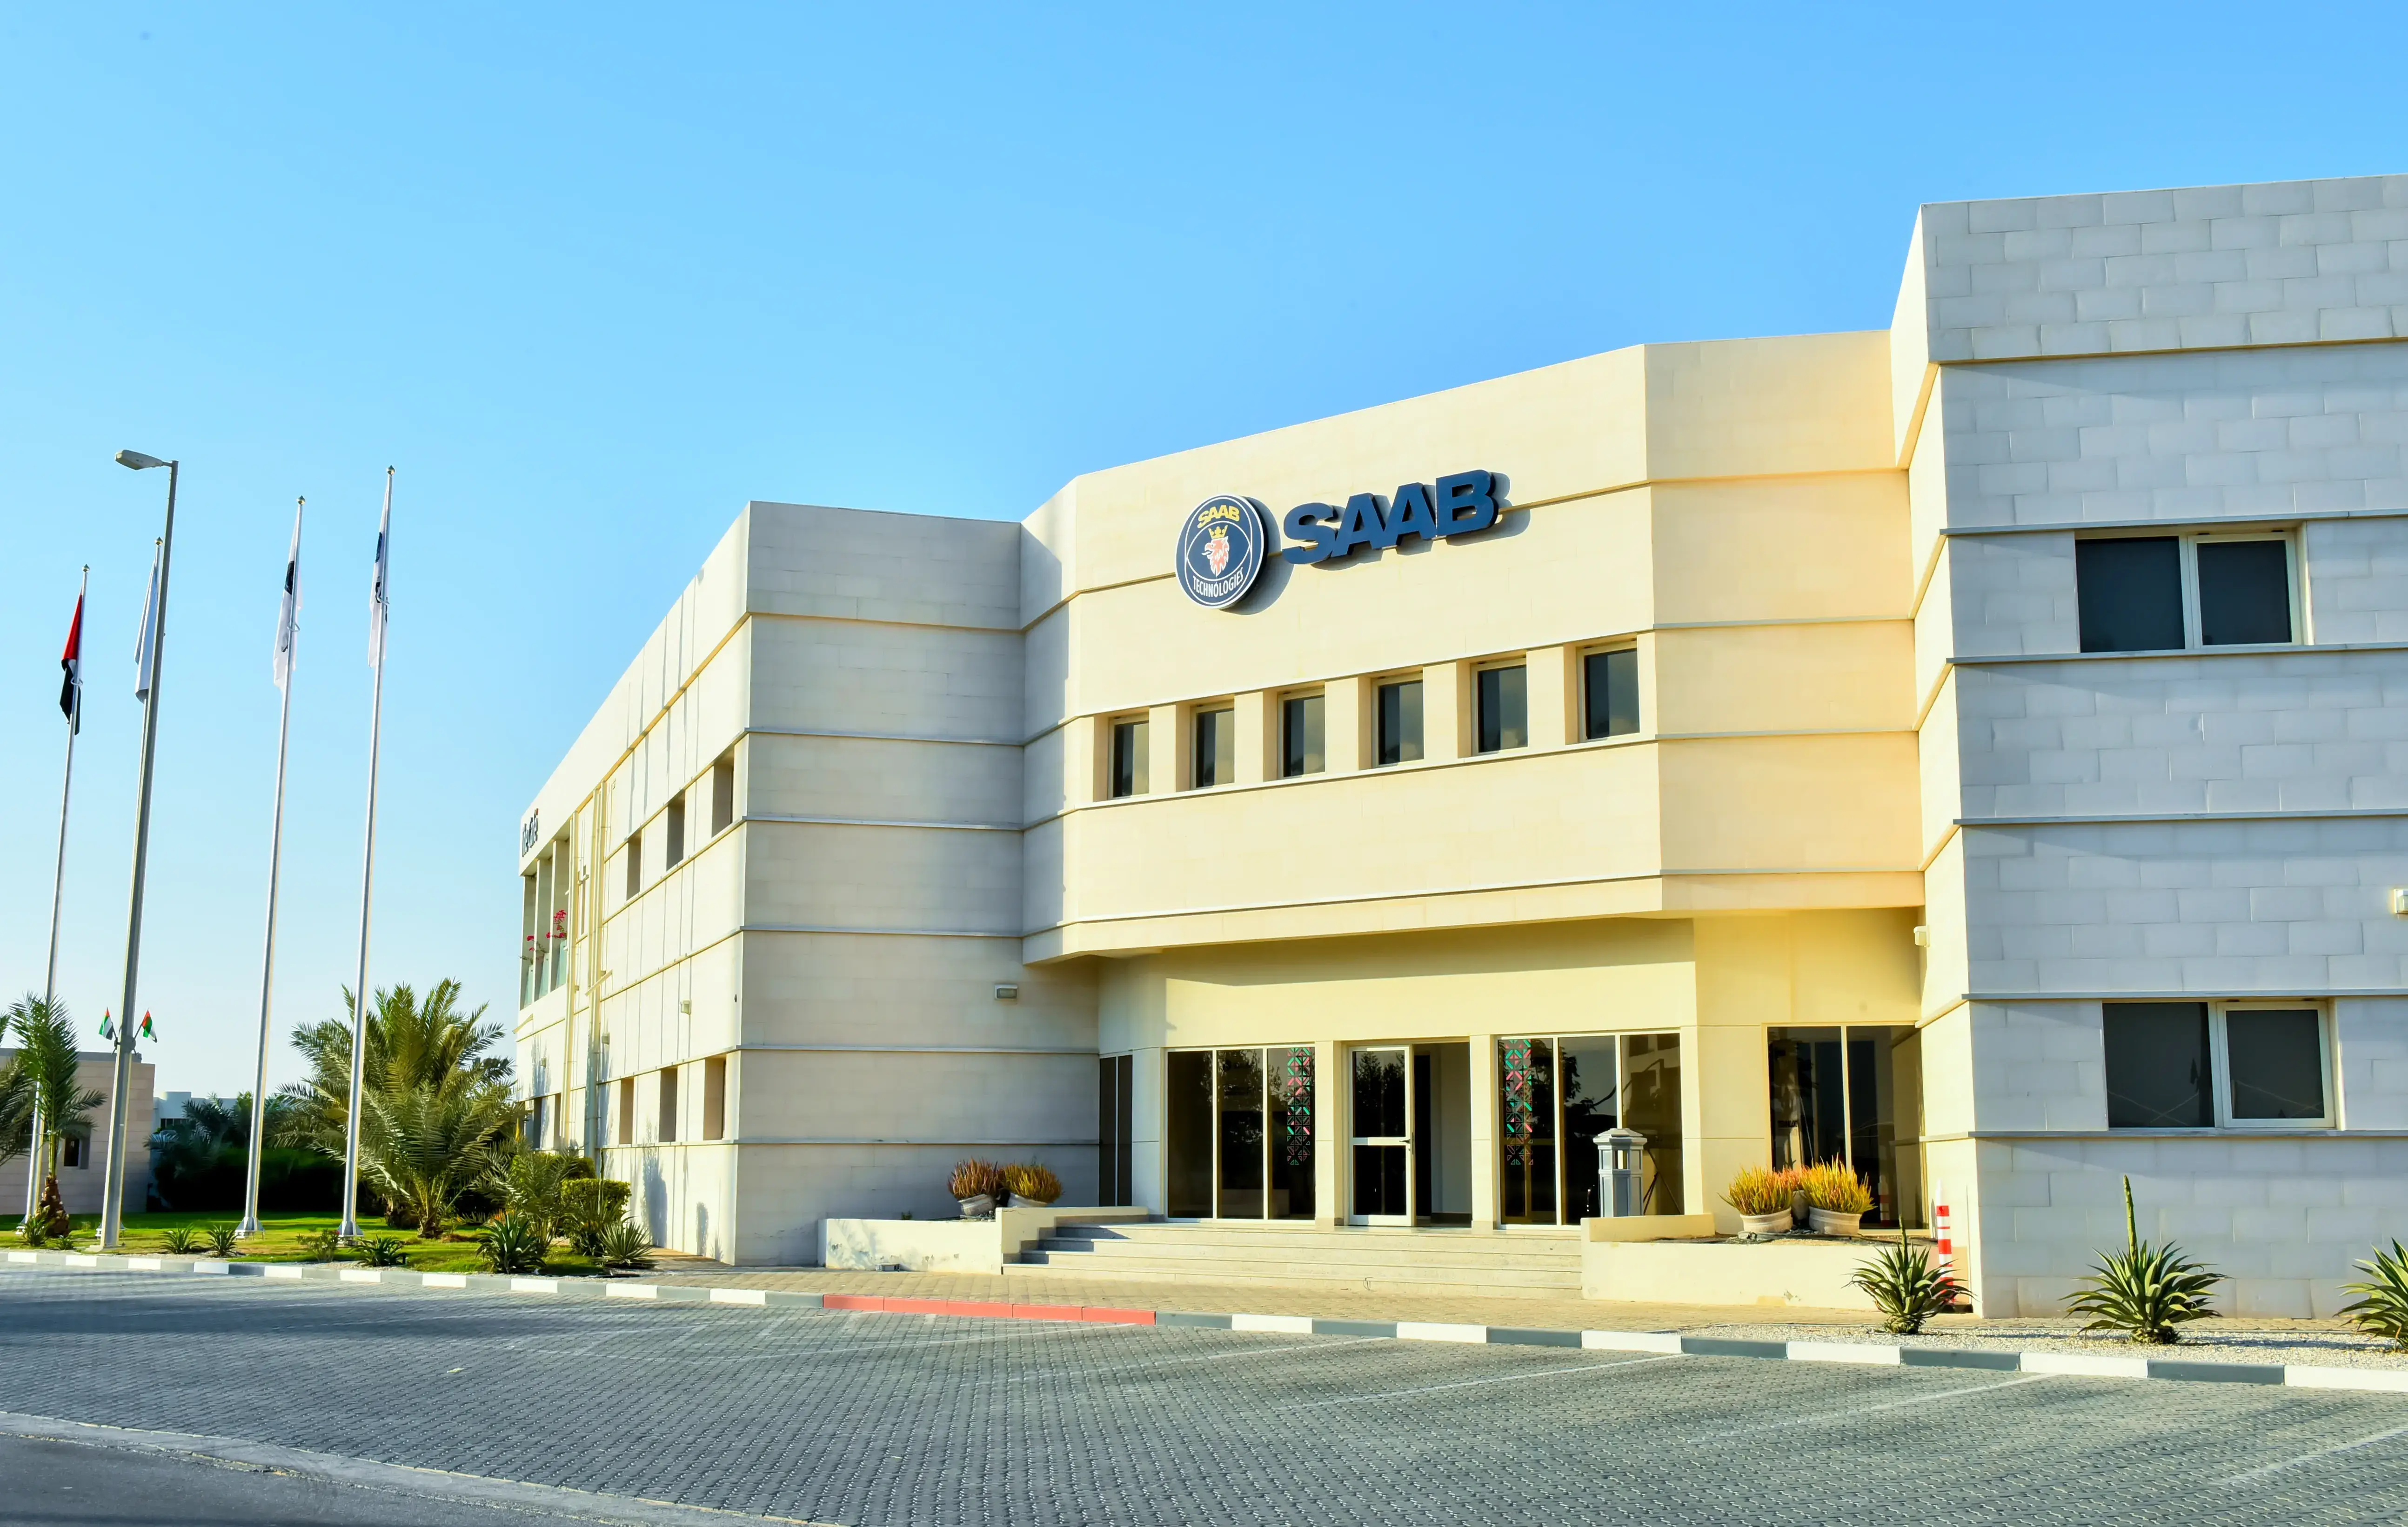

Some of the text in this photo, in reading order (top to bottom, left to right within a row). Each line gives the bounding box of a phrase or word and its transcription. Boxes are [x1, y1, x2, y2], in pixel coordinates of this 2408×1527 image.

[1197, 505, 1240, 528] SAAB
[1282, 469, 1498, 565] SAAB
[1193, 567, 1244, 598] TECHNOLOGIES
